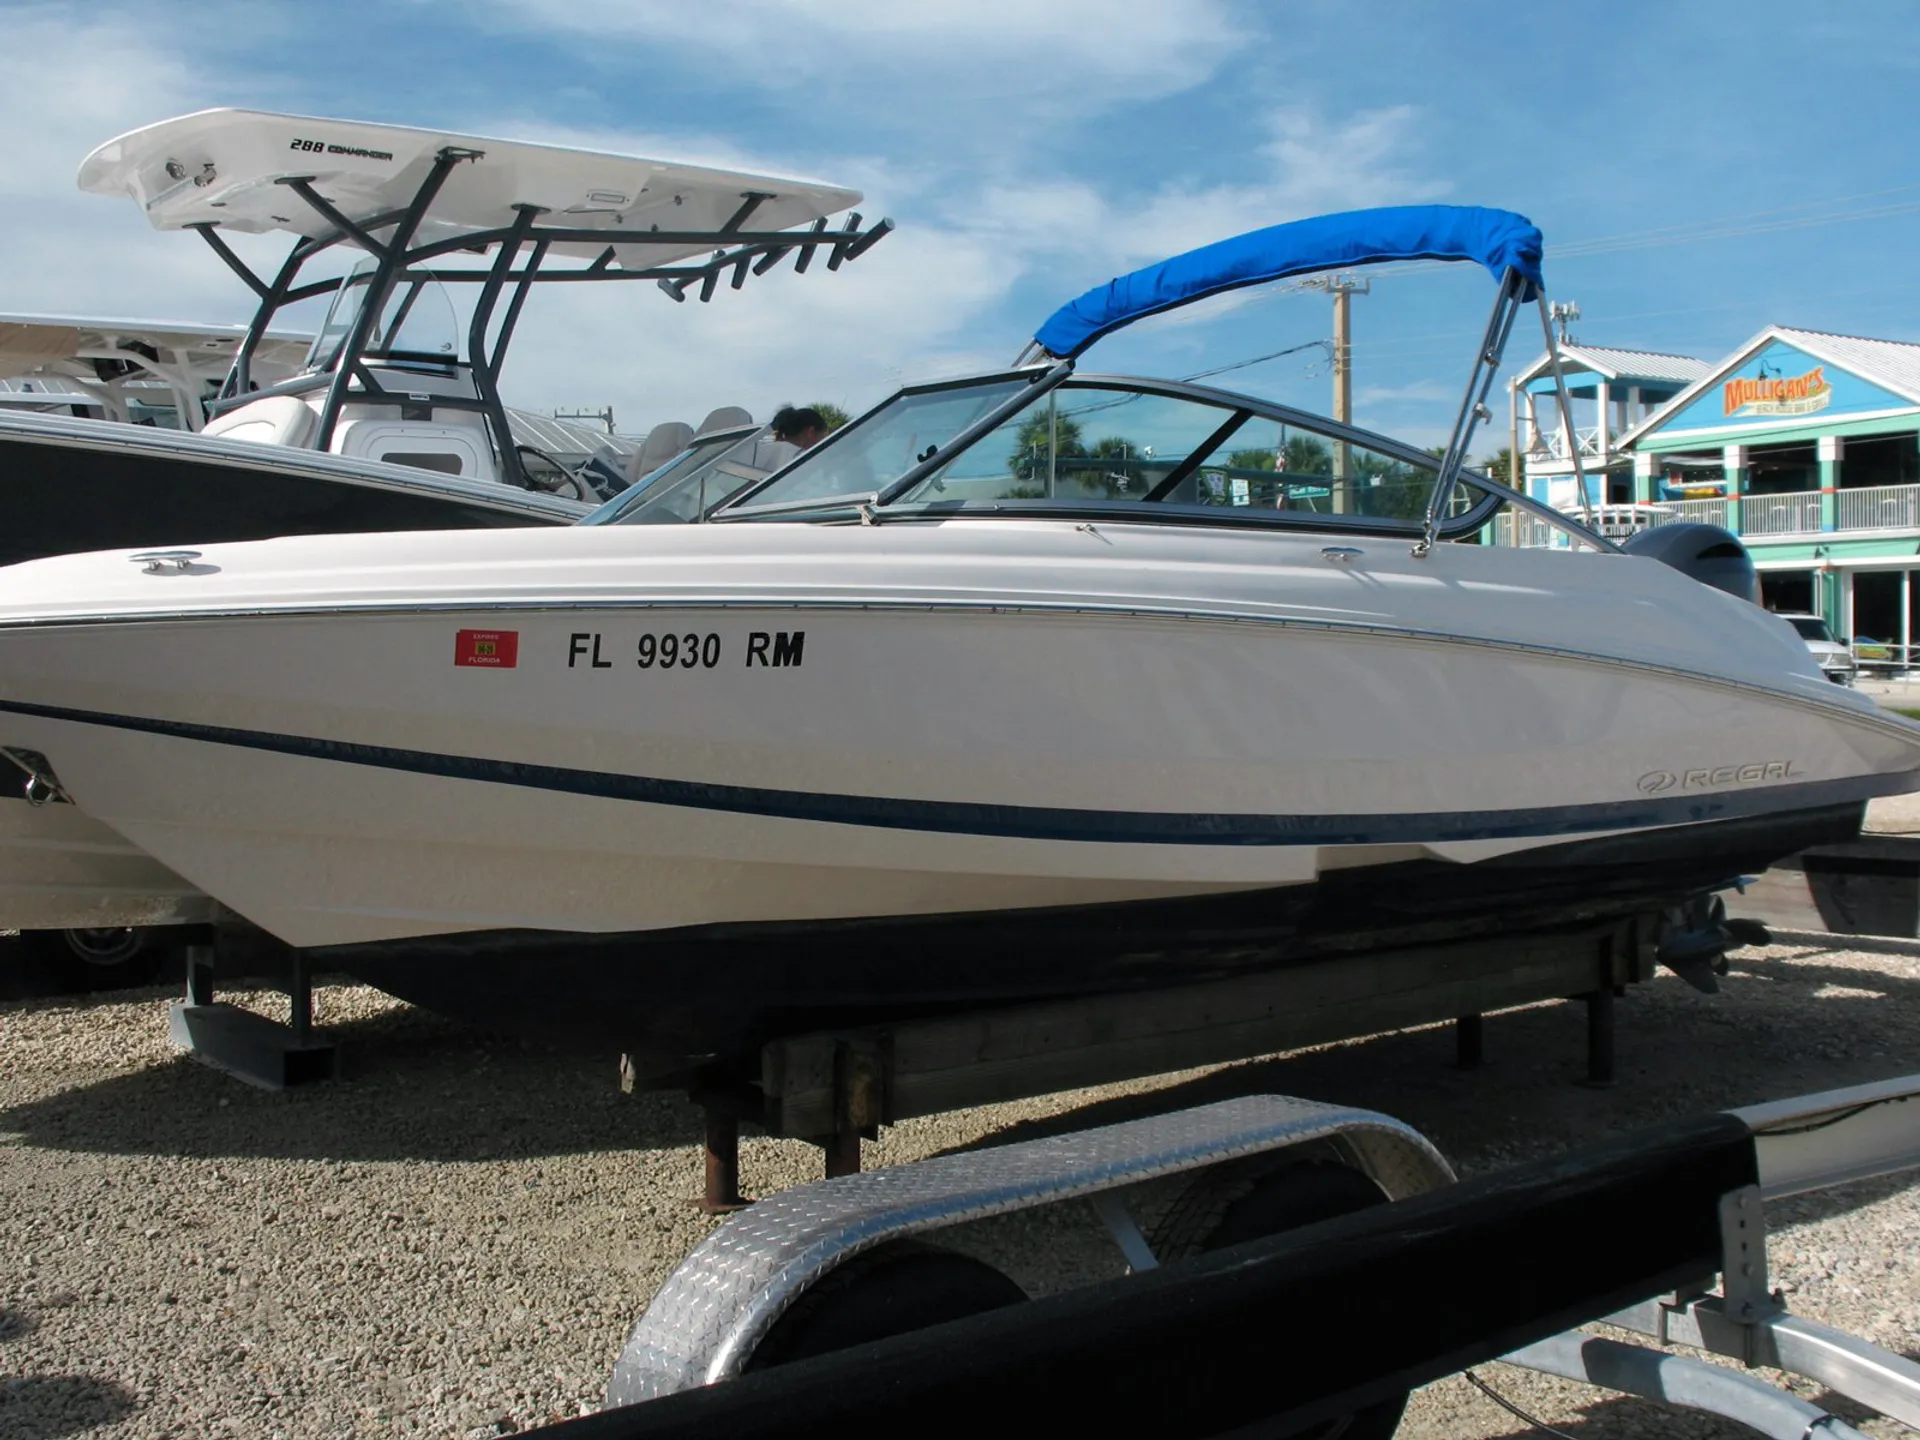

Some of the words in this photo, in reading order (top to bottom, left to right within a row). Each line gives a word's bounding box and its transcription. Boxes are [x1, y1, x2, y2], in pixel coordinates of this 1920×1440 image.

[290, 138, 325, 153] 288
[327, 144, 393, 161] COMMANDER
[1724, 366, 1825, 416] MULLIGAN'S
[468, 656, 501, 664] FLORIDA
[568, 633, 612, 668] FL
[638, 633, 721, 668] 9930
[746, 631, 805, 667] RM
[1683, 760, 1806, 789] REGAL
